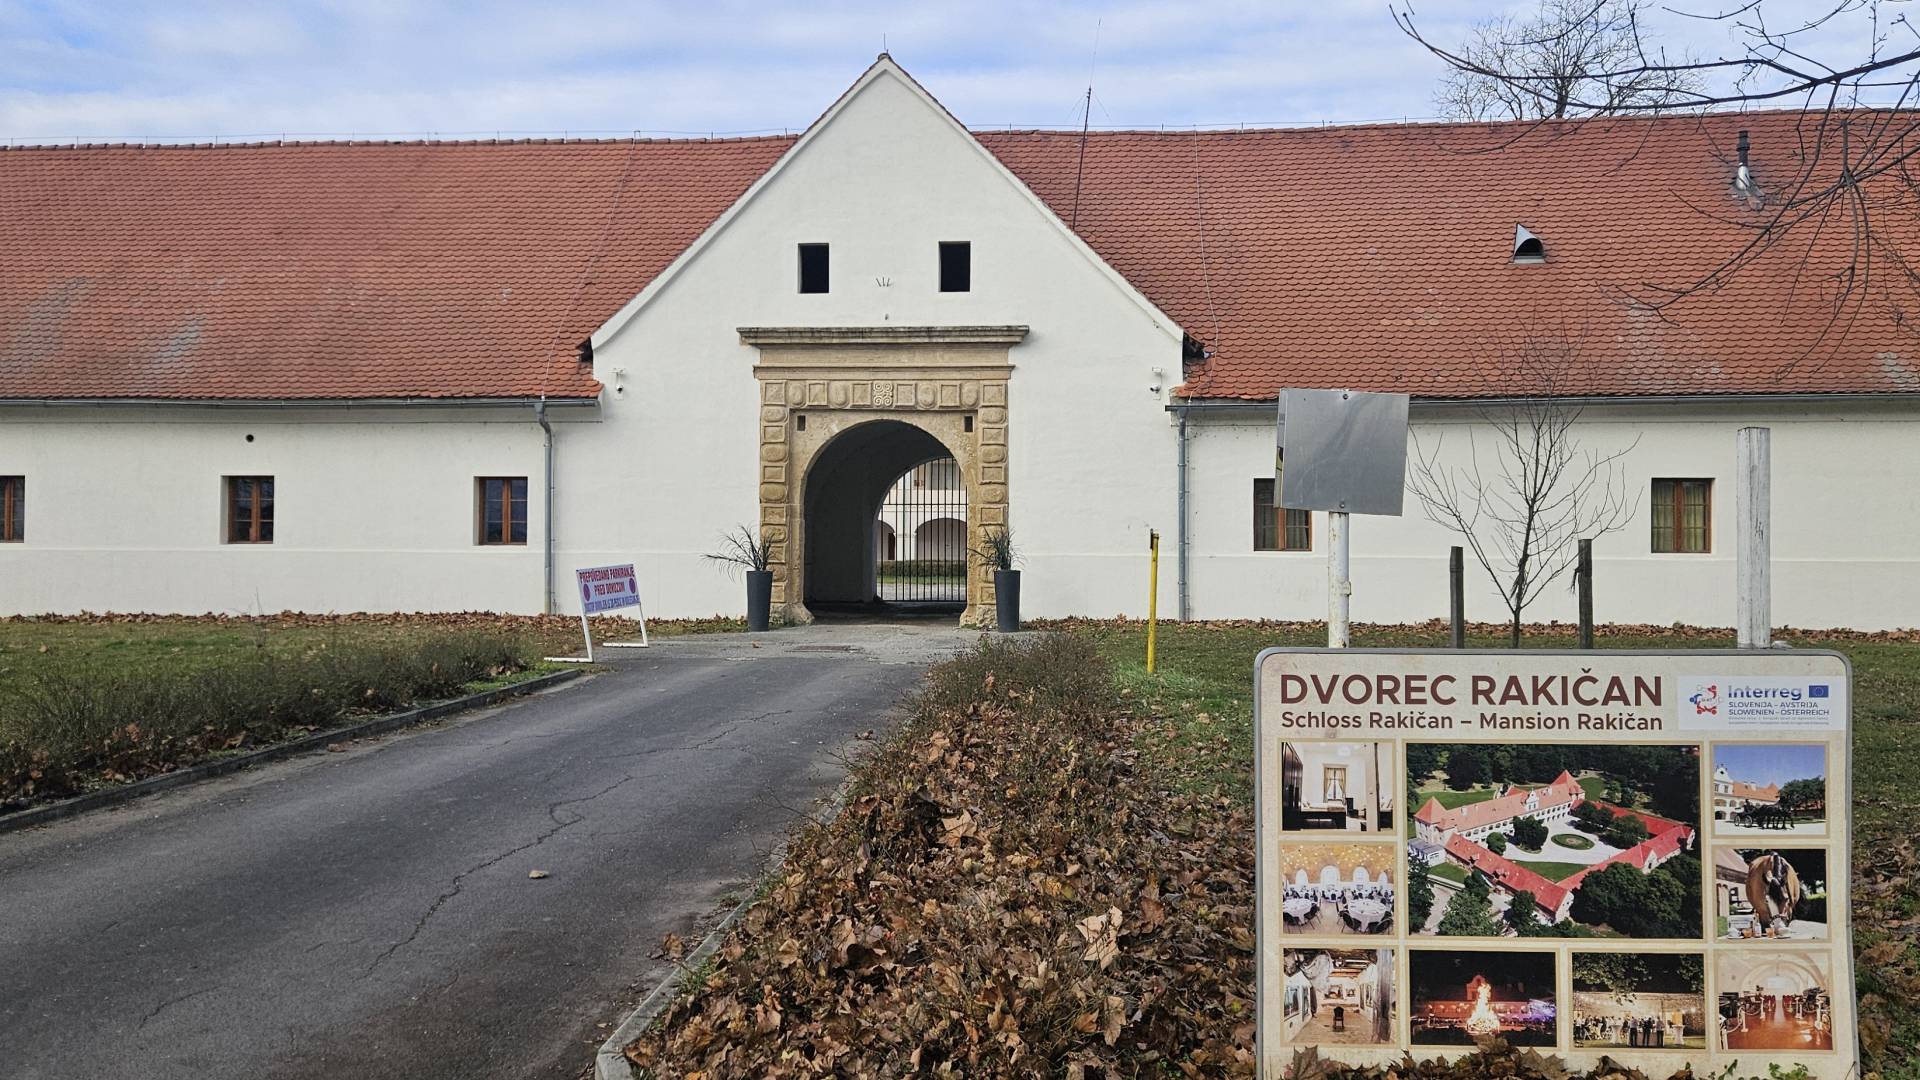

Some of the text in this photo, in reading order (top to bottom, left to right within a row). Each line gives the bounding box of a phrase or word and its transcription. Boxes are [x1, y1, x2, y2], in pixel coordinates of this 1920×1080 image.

[1281, 667, 1662, 706] DVOREC RAKIČAN
[1728, 685, 1802, 701] Interreg
[1281, 711, 1362, 729] Schloss
[1369, 711, 1453, 729] Rakičan
[1480, 712, 1570, 730] Mansion
[1577, 712, 1663, 730] Rakičan
